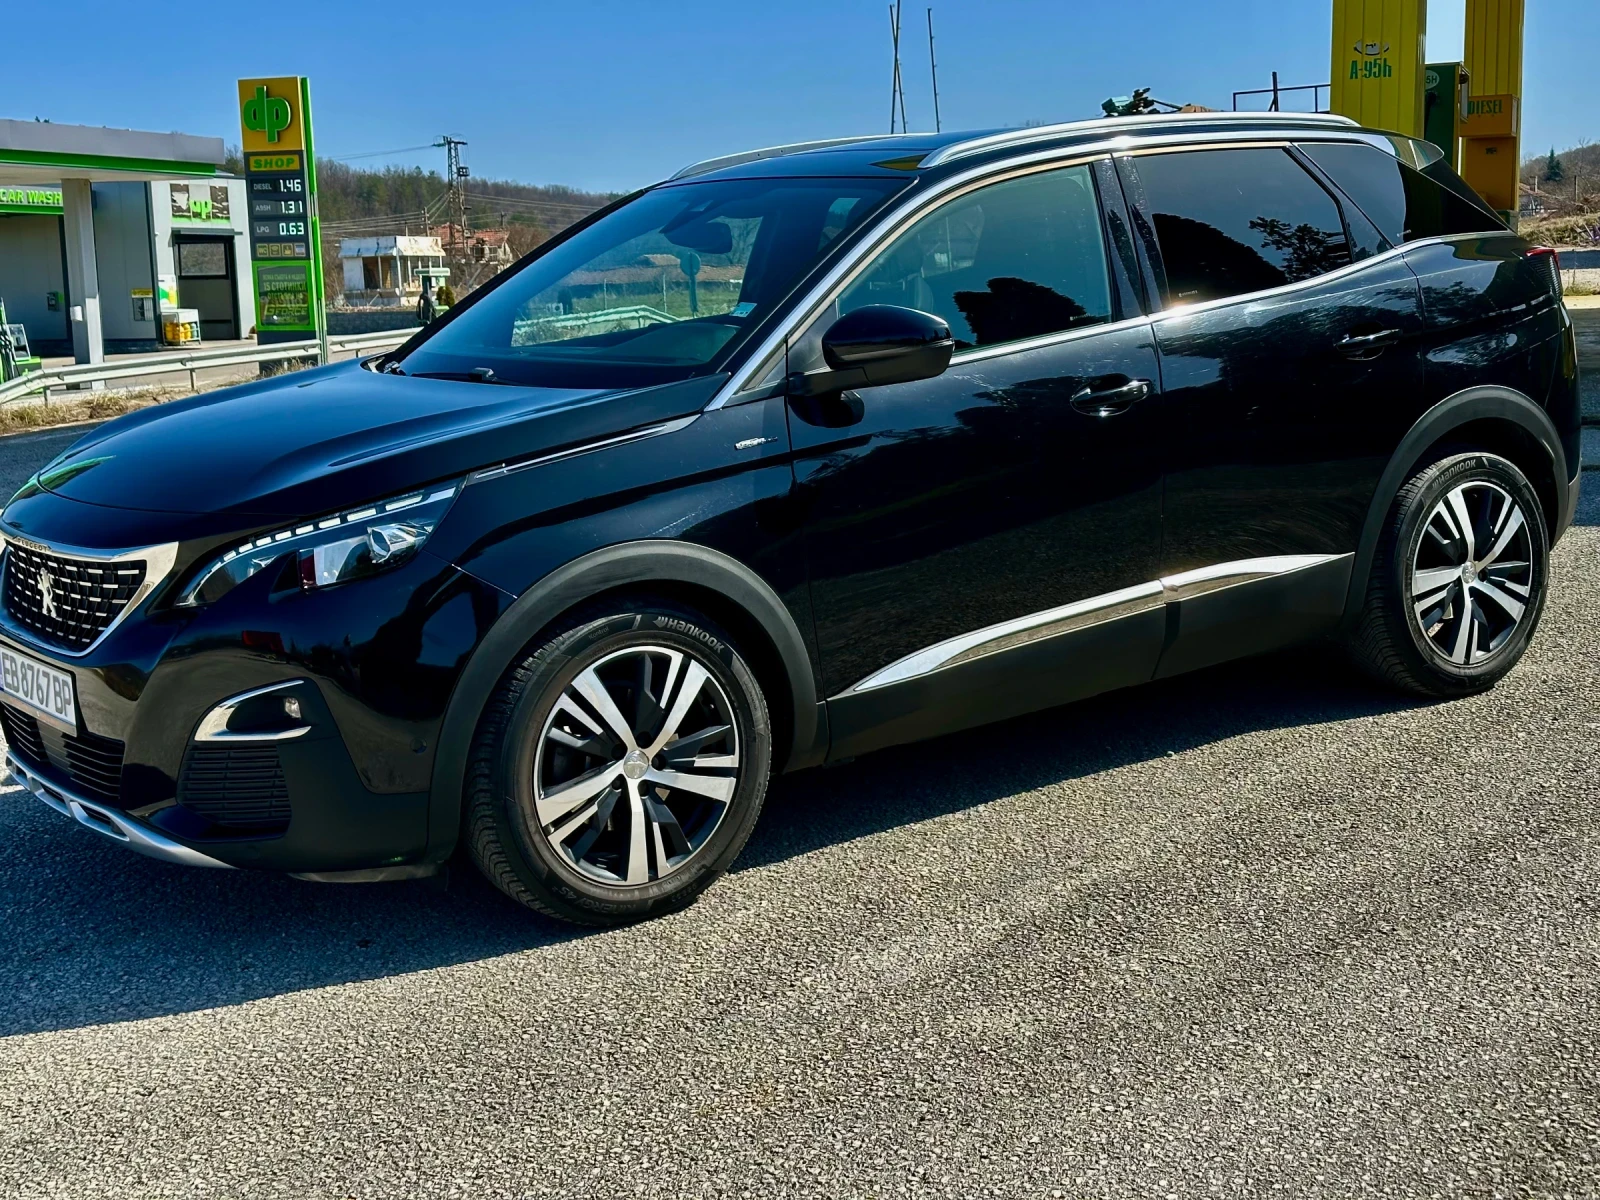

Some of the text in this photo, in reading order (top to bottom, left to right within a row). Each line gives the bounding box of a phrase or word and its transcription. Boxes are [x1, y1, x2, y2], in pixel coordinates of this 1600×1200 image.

[243, 85, 291, 142] dp
[1468, 100, 1503, 115] DIESEL
[253, 157, 295, 169] SHOP
[280, 179, 302, 192] 1.46
[0, 188, 62, 204] CAR WASH
[281, 200, 303, 214] 1.31
[279, 222, 304, 235] 0.63
[20, 661, 50, 708] 8767
